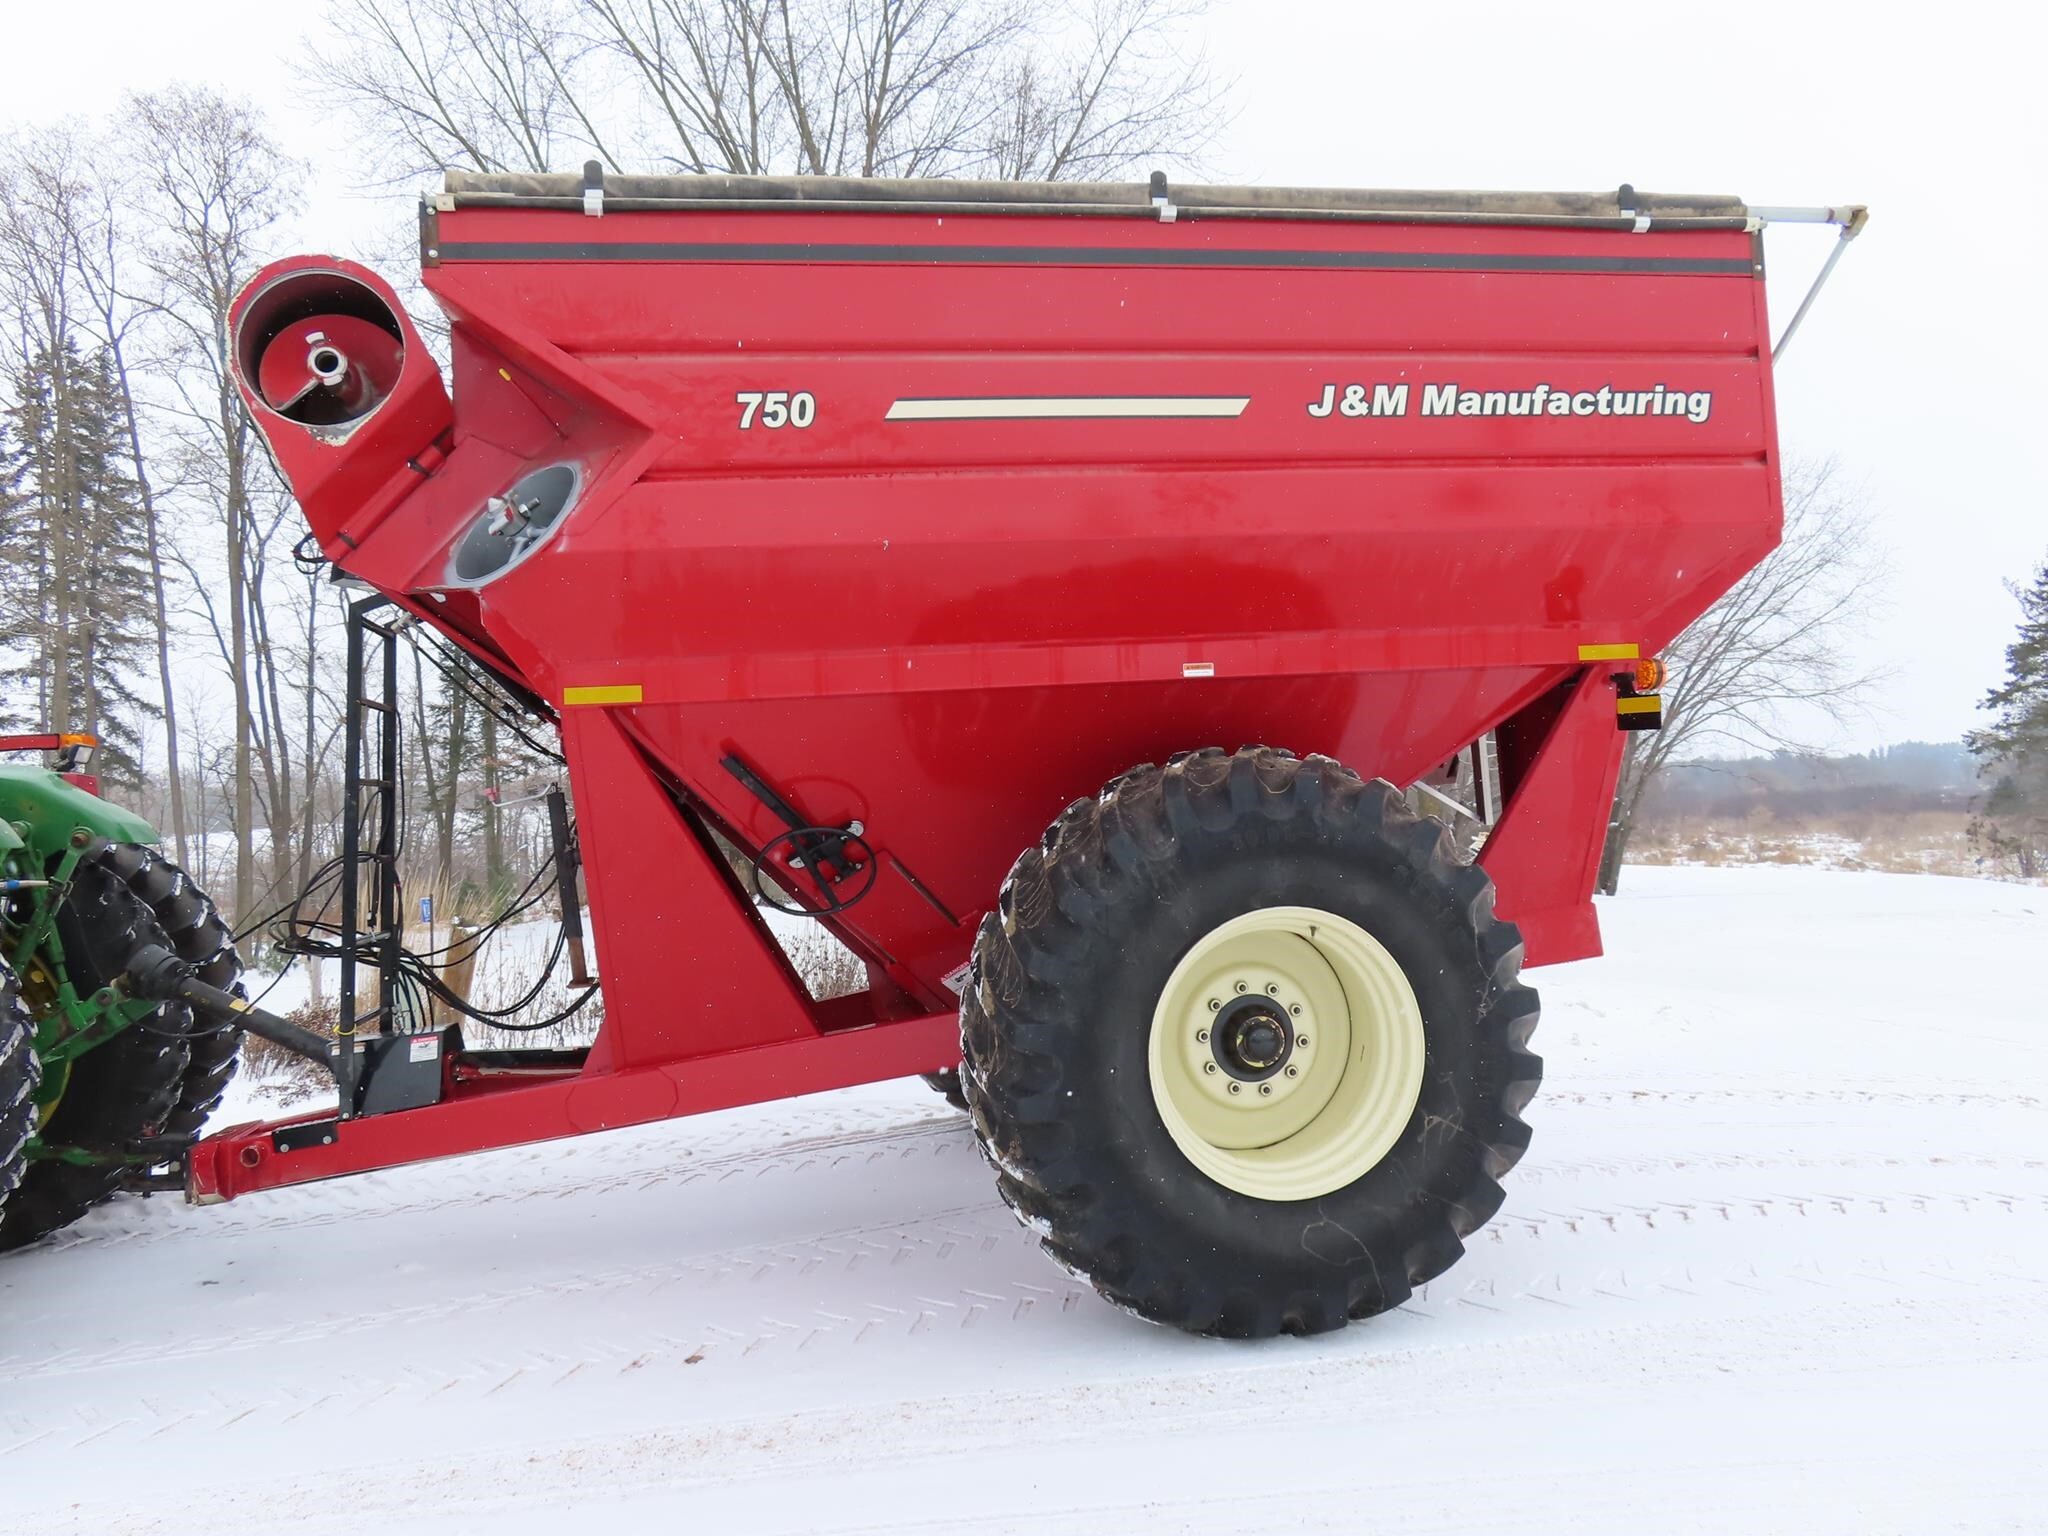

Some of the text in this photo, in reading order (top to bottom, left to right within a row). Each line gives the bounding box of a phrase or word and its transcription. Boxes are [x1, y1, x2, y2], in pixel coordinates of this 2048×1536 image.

[736, 391, 815, 429] 750
[1308, 384, 1711, 424] J&M Manufacturing
